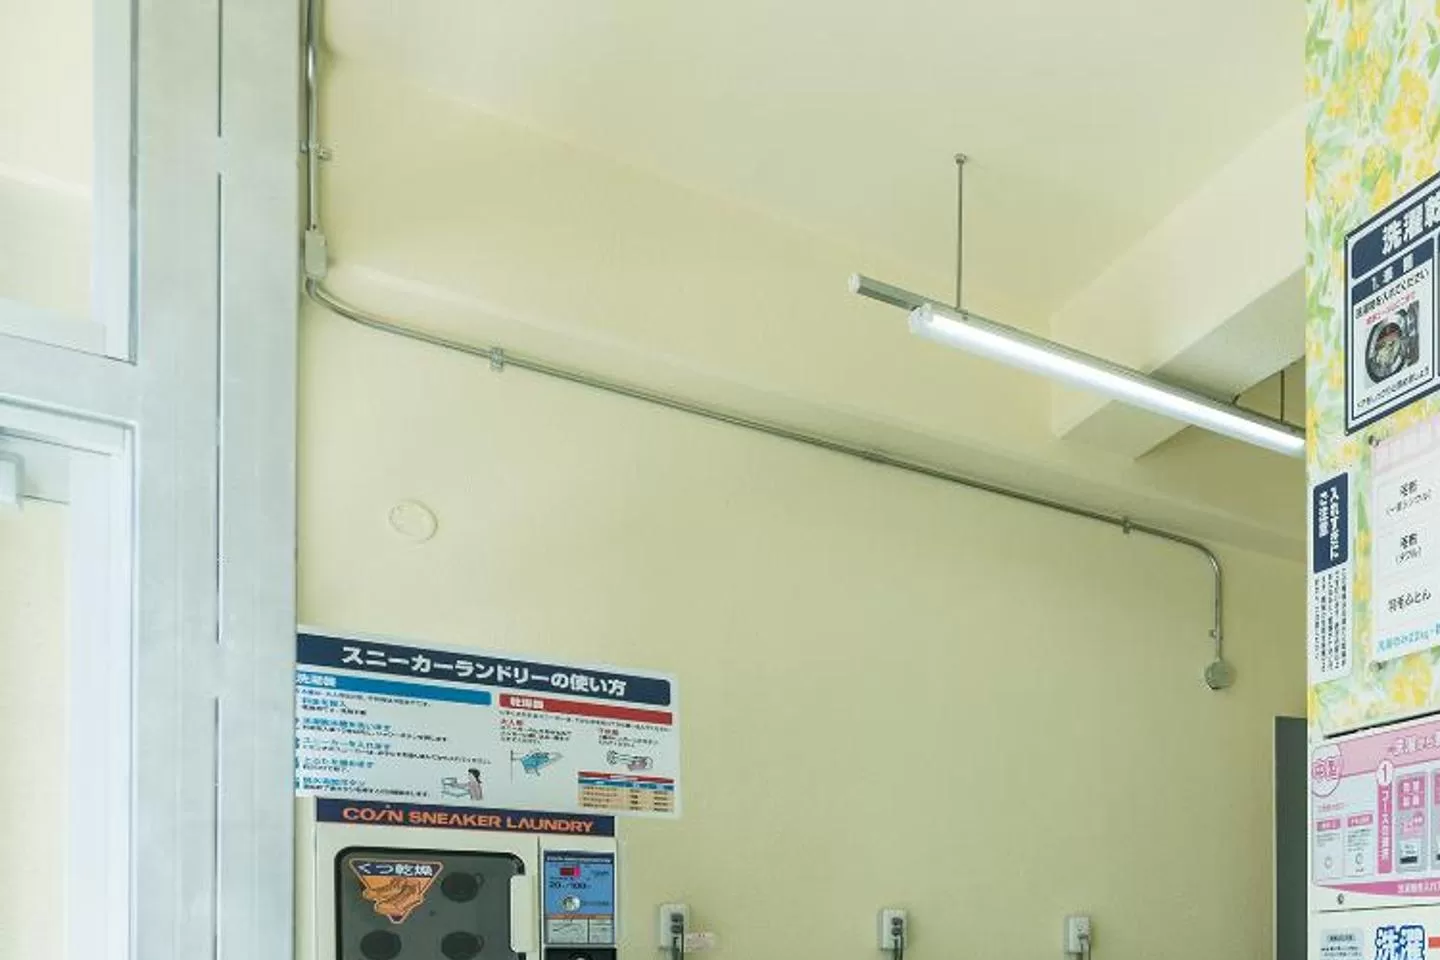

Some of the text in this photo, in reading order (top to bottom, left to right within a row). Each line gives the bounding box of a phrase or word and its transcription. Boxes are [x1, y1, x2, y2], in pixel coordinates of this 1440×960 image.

[341, 645, 628, 696] スニーカーランドリーの使い方
[408, 811, 501, 828] SNEAKER
[506, 817, 594, 834] LAUNDRY
[356, 862, 433, 878] くつ乾燥
